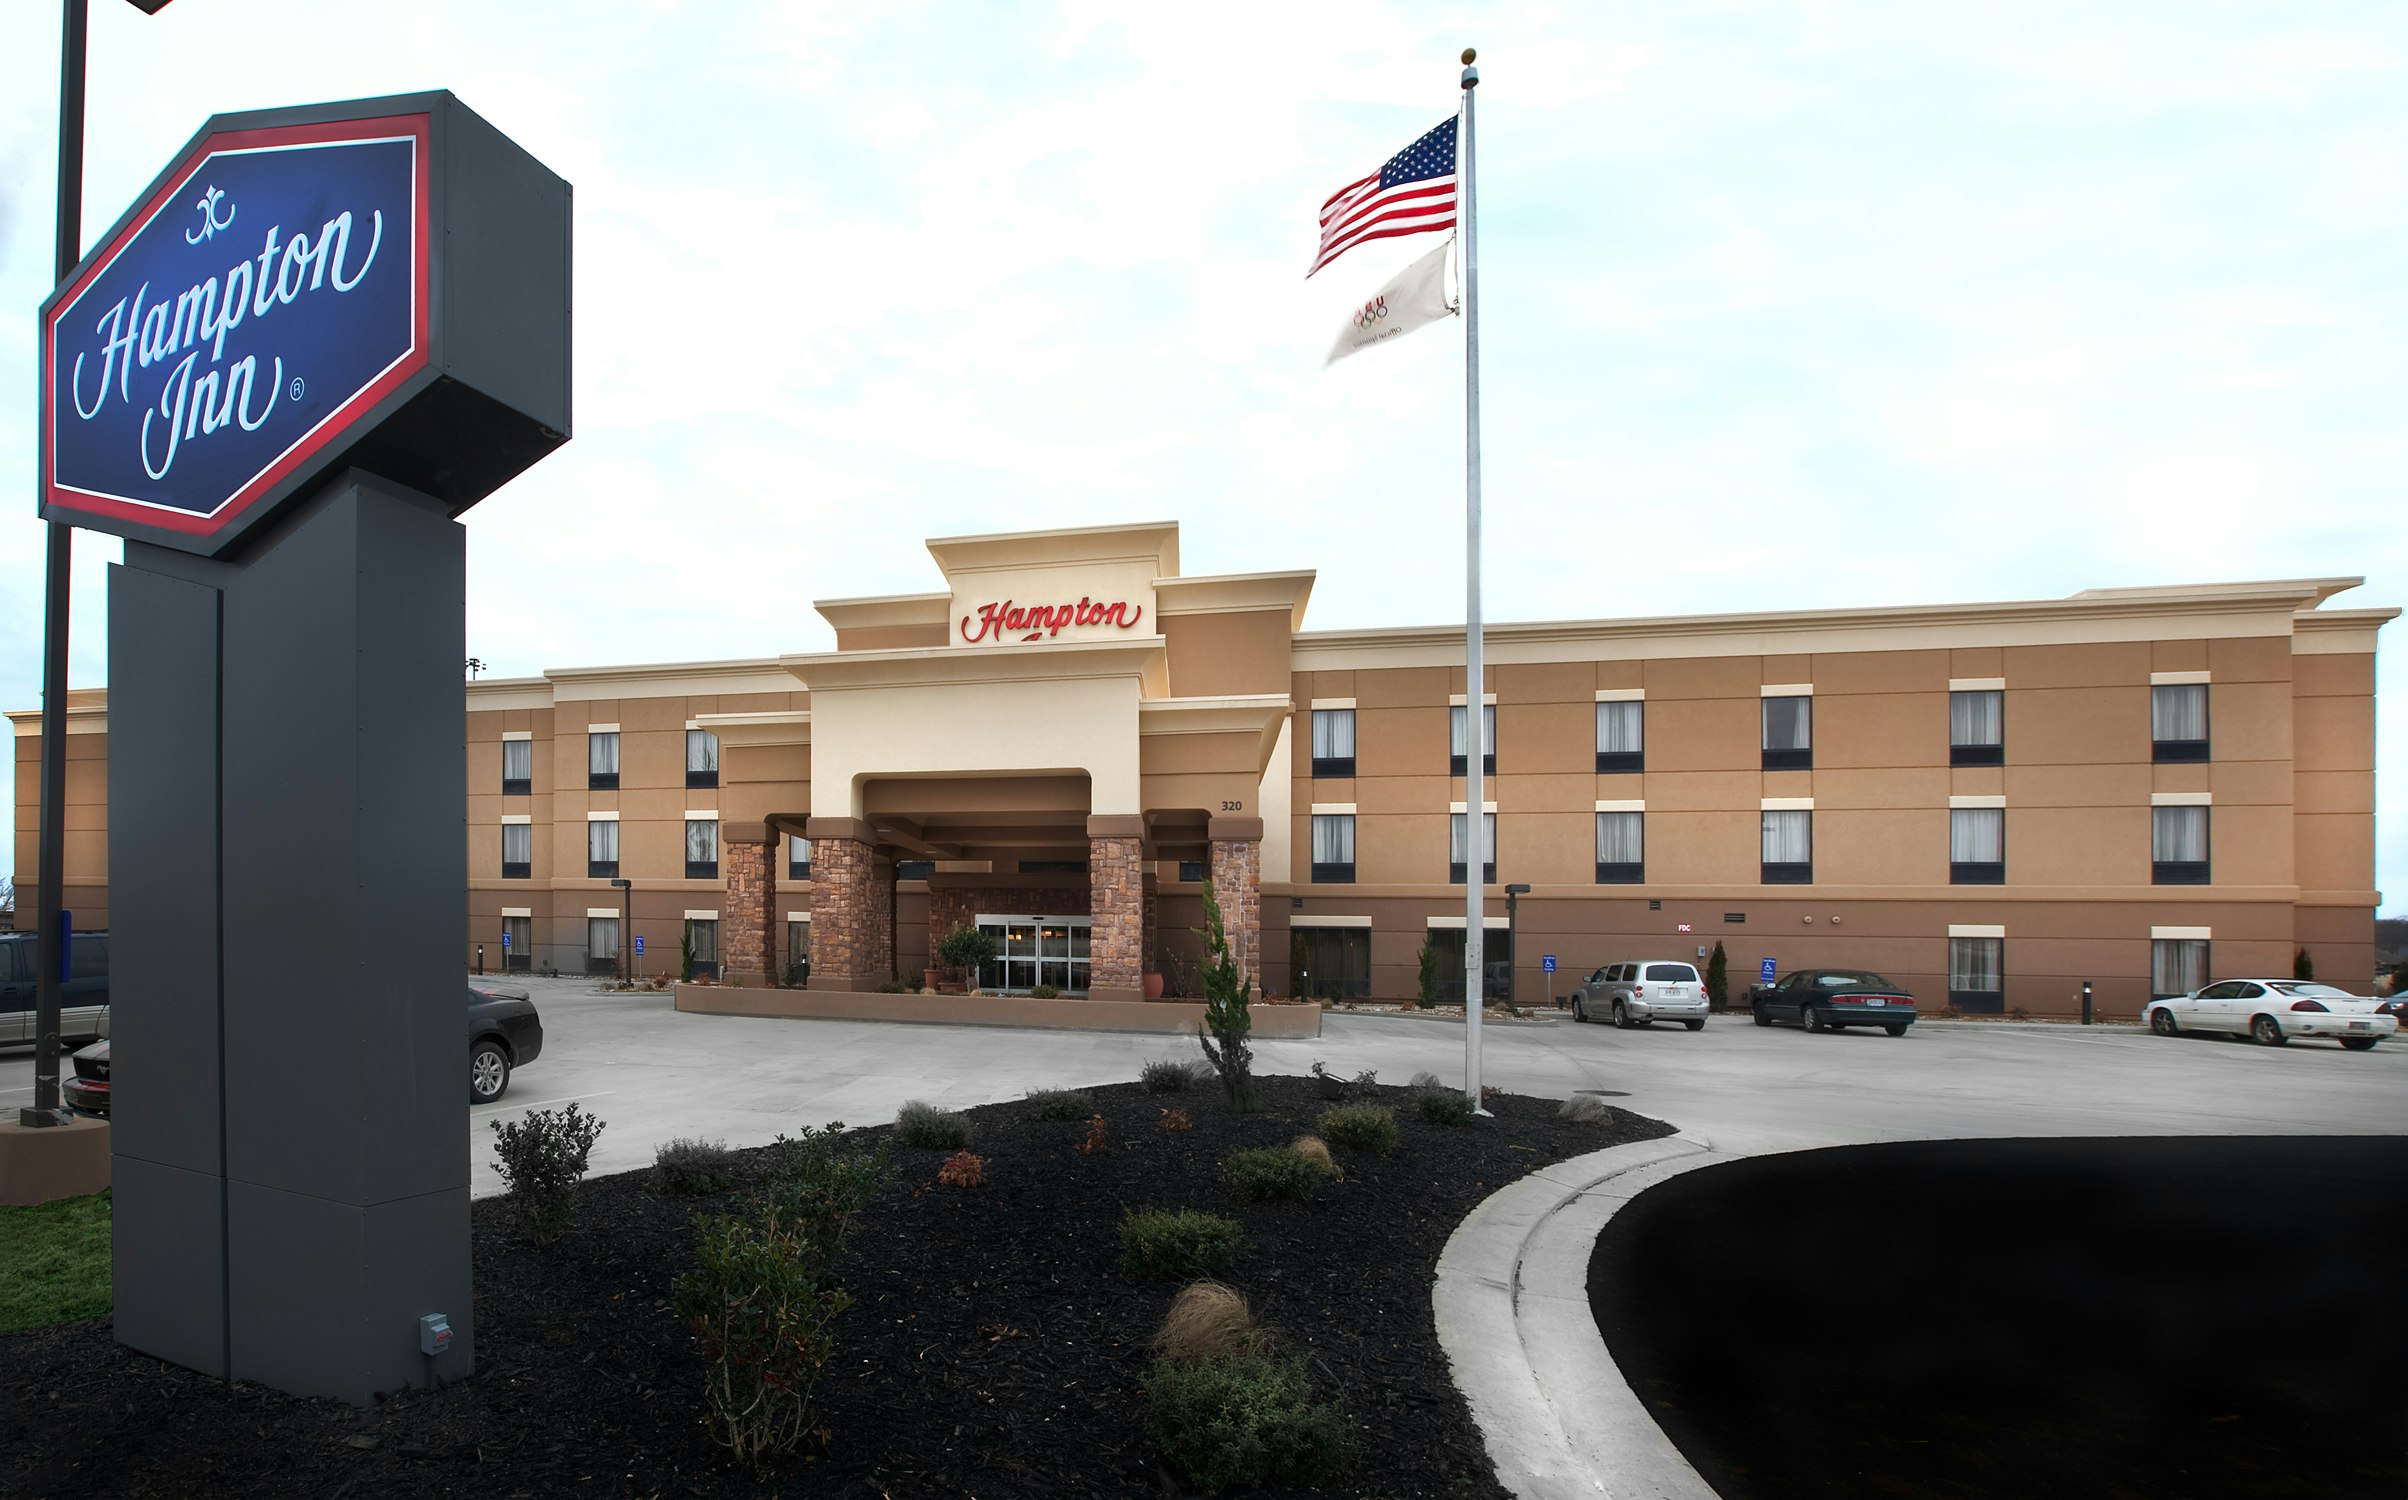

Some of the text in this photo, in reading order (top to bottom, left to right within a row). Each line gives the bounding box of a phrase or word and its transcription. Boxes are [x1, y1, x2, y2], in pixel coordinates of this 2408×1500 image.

[74, 209, 383, 420] Hampton
[141, 350, 282, 481] Inn
[961, 596, 1142, 643] Hampton
[1221, 801, 1243, 811] 320
[1678, 924, 1691, 932] FDC
